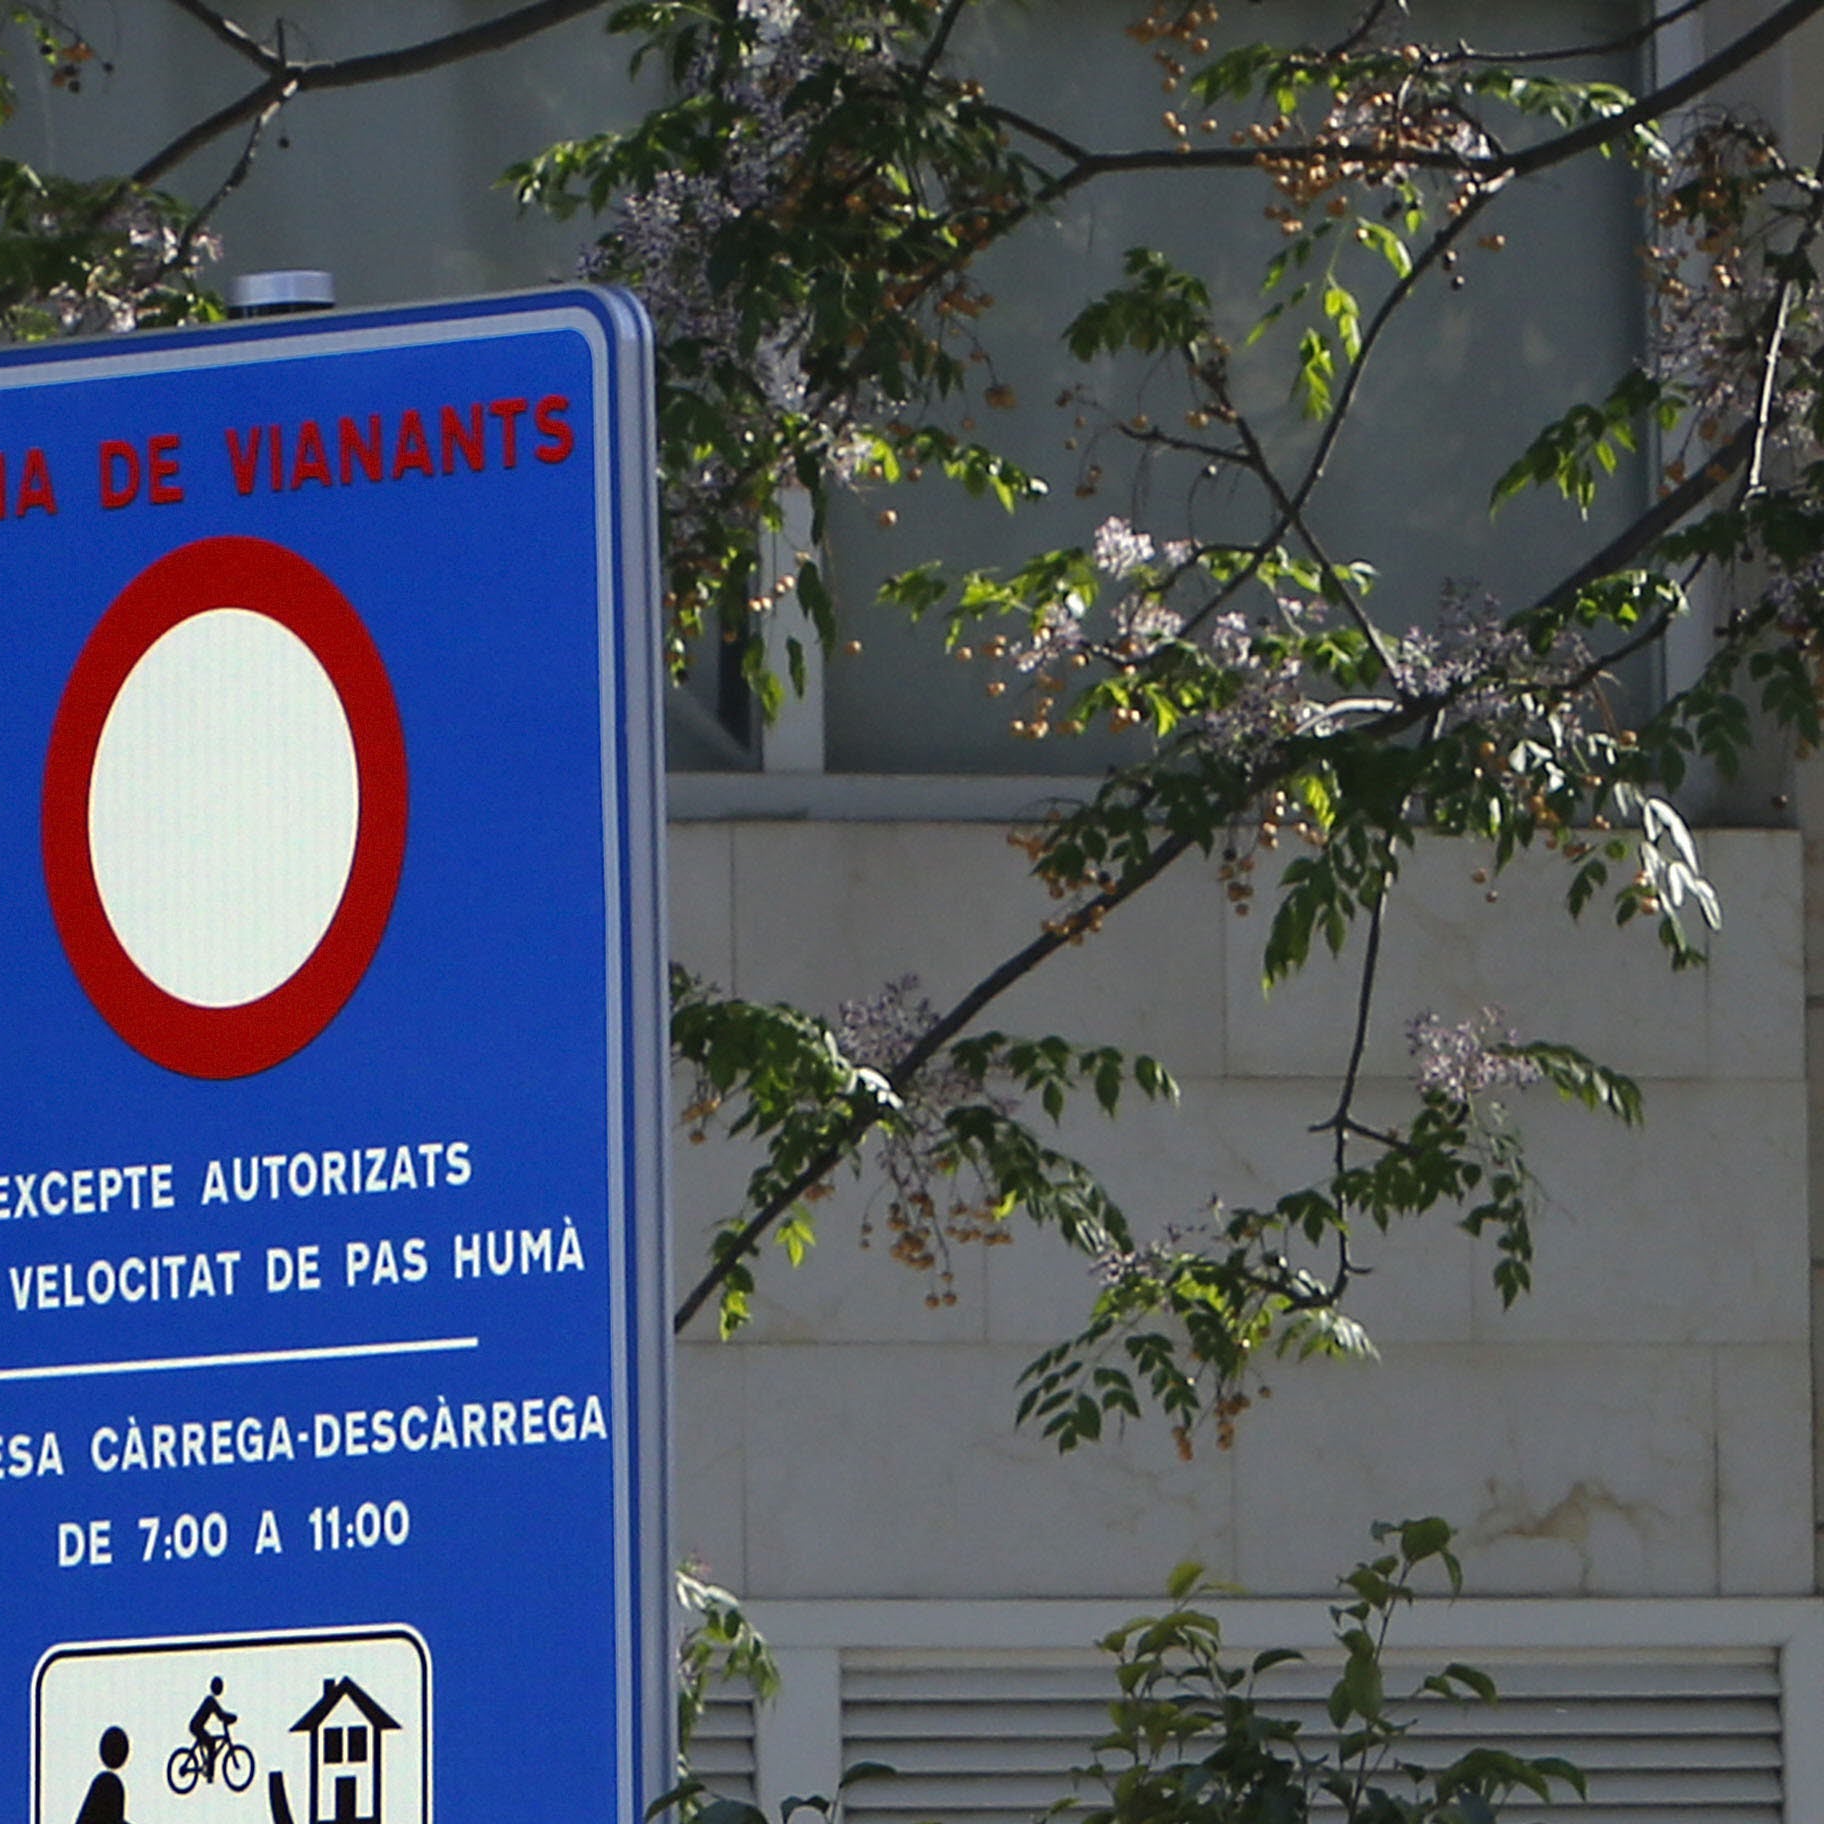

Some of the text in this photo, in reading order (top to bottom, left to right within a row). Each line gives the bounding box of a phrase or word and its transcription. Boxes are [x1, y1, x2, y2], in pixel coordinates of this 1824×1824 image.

[98, 434, 183, 509] DE
[225, 395, 575, 496] VIANANTS
[201, 1141, 473, 1205] AUTORIZATS
[8, 1250, 242, 1311] VELOCITAT
[266, 1245, 322, 1293] DE
[346, 1237, 429, 1287] PAS
[454, 1215, 586, 1279] HUMÀ
[90, 1394, 609, 1473] CÀRREGA-DESCÀRREGA
[58, 1500, 411, 1567] DE 7:00 A 11:00
